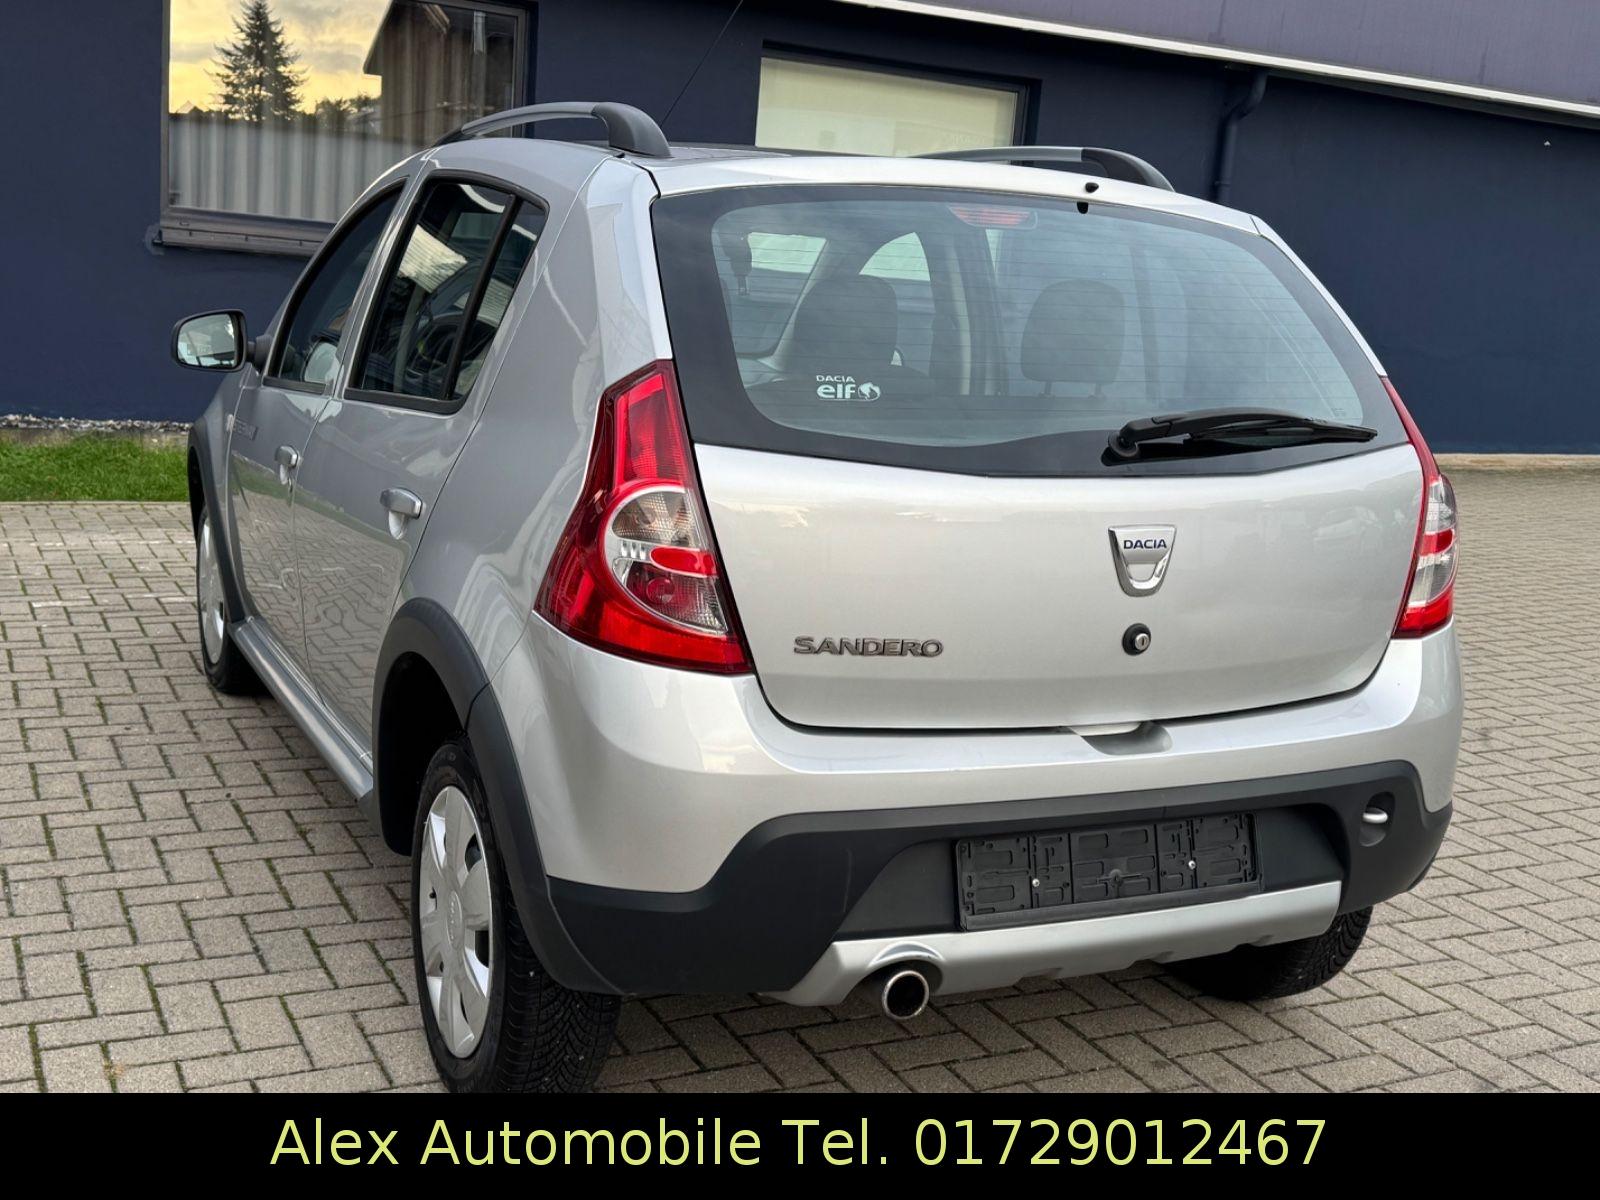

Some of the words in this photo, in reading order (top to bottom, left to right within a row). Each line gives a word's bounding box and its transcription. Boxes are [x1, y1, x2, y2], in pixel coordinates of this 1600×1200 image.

[816, 375, 855, 383] DACIA
[817, 384, 856, 399] elf
[1124, 539, 1167, 549] DACIA
[794, 636, 944, 657] SANDERO
